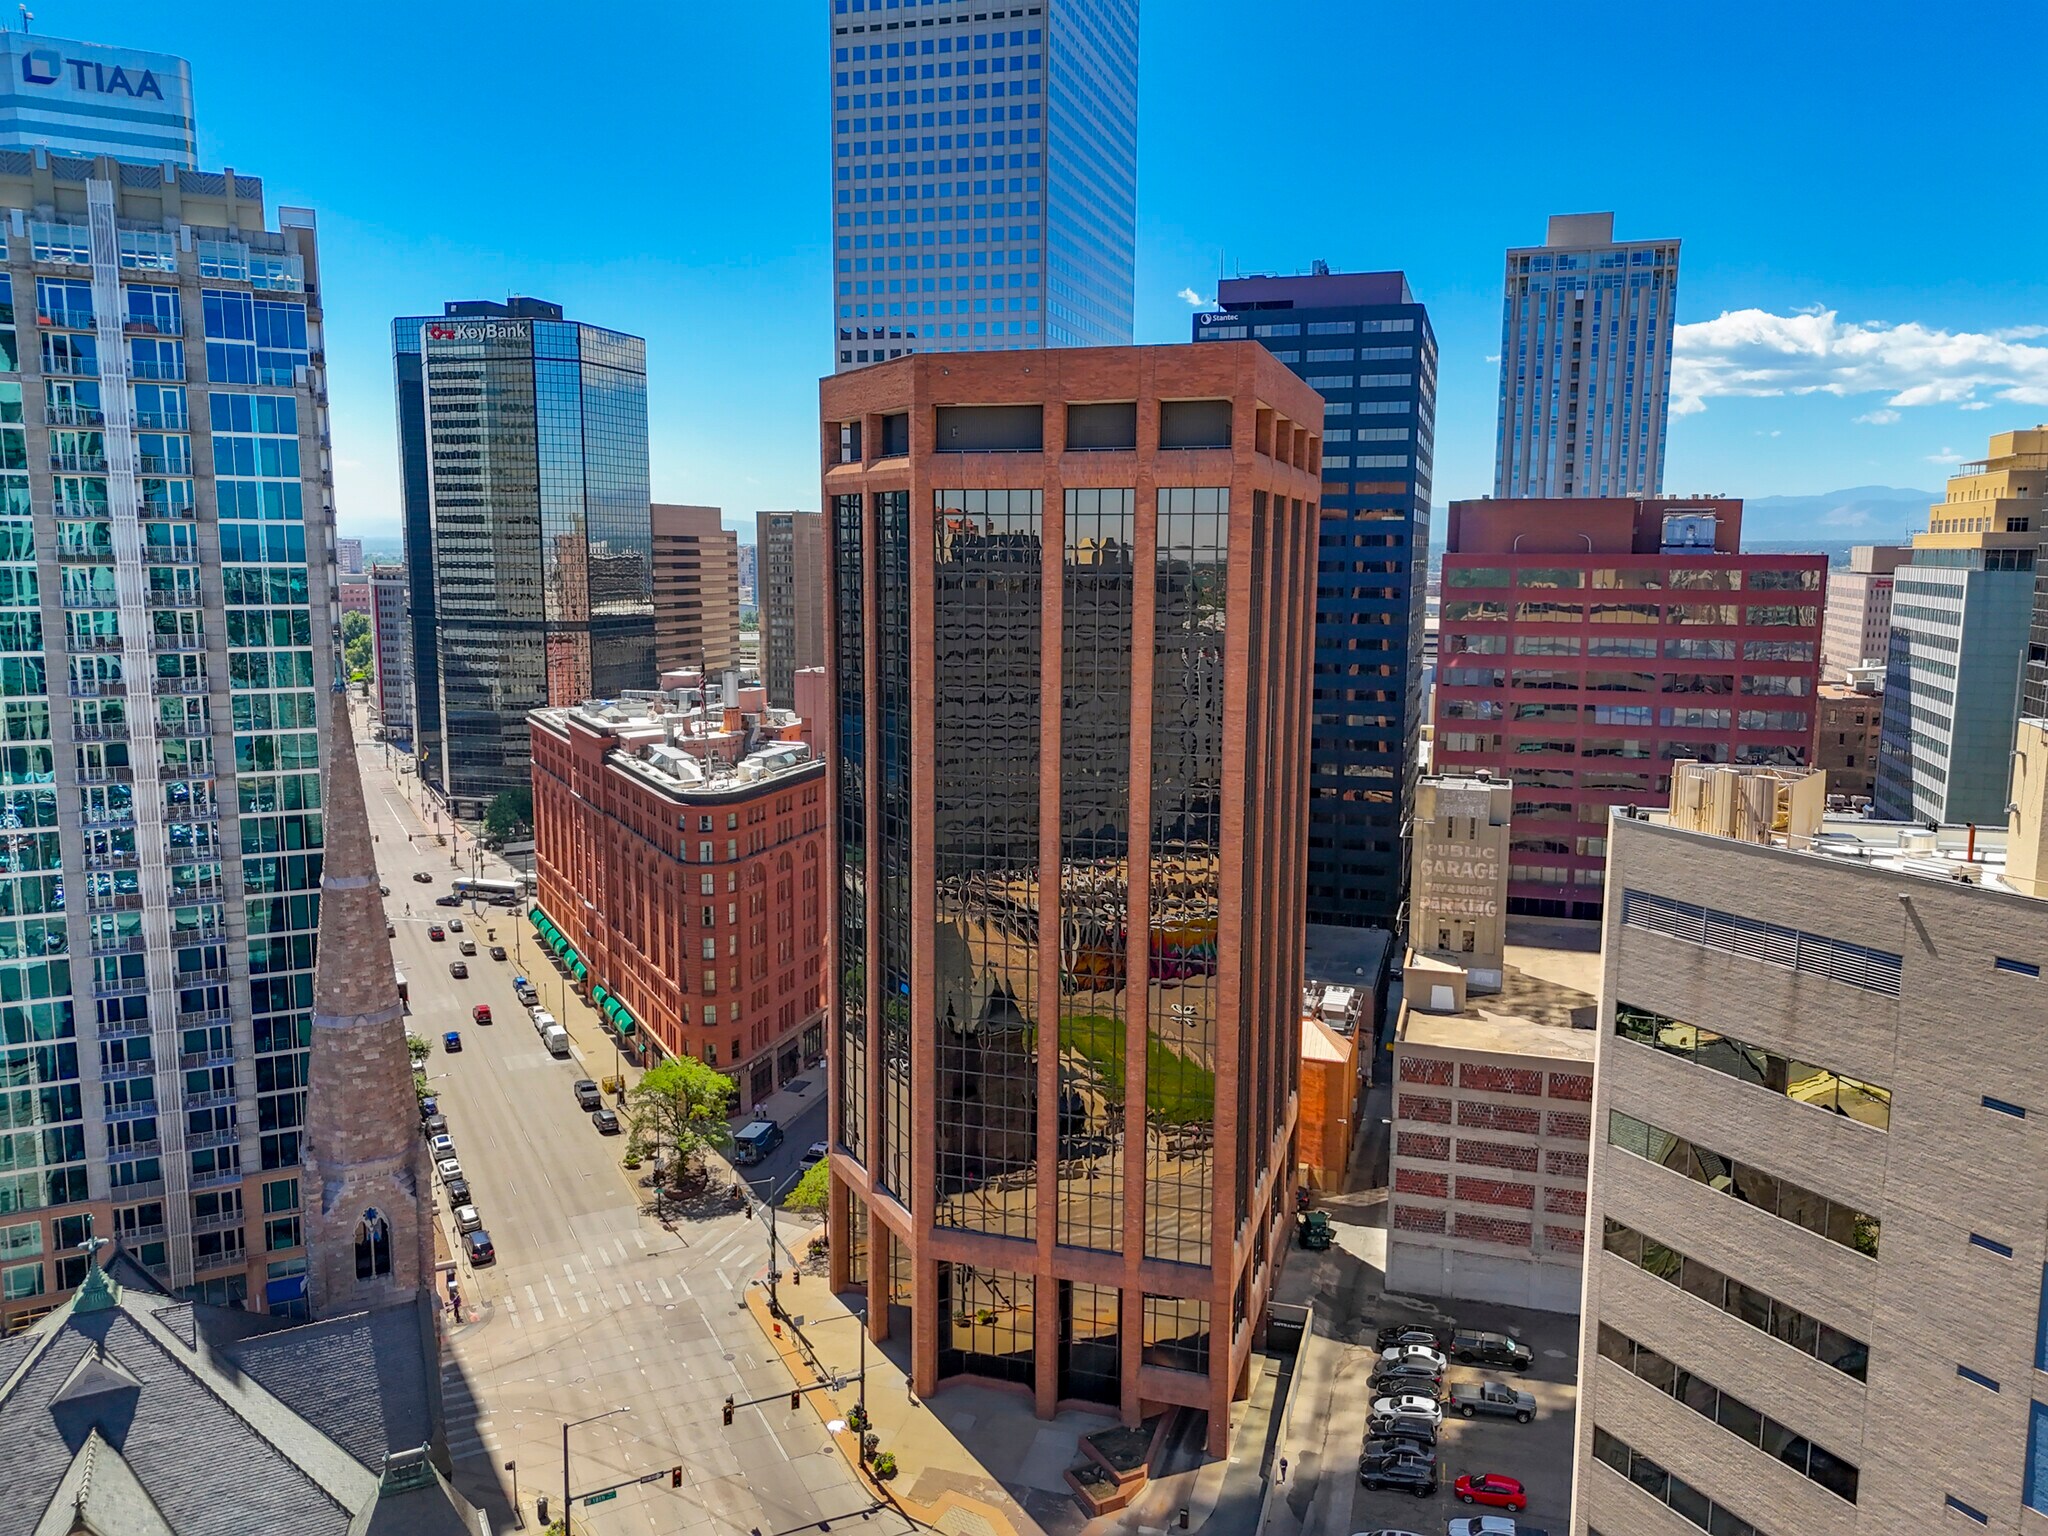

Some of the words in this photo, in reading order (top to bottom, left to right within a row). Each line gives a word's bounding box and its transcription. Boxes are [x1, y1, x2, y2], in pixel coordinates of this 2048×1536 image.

[66, 58, 164, 101] TIAA
[1212, 314, 1239, 322] Stantec
[457, 323, 527, 343] KeyBank
[1426, 843, 1495, 859] PUBLIC
[1420, 859, 1499, 880] GARAGE
[1457, 884, 1495, 896] NIGHT
[1419, 895, 1498, 917] PARKING
